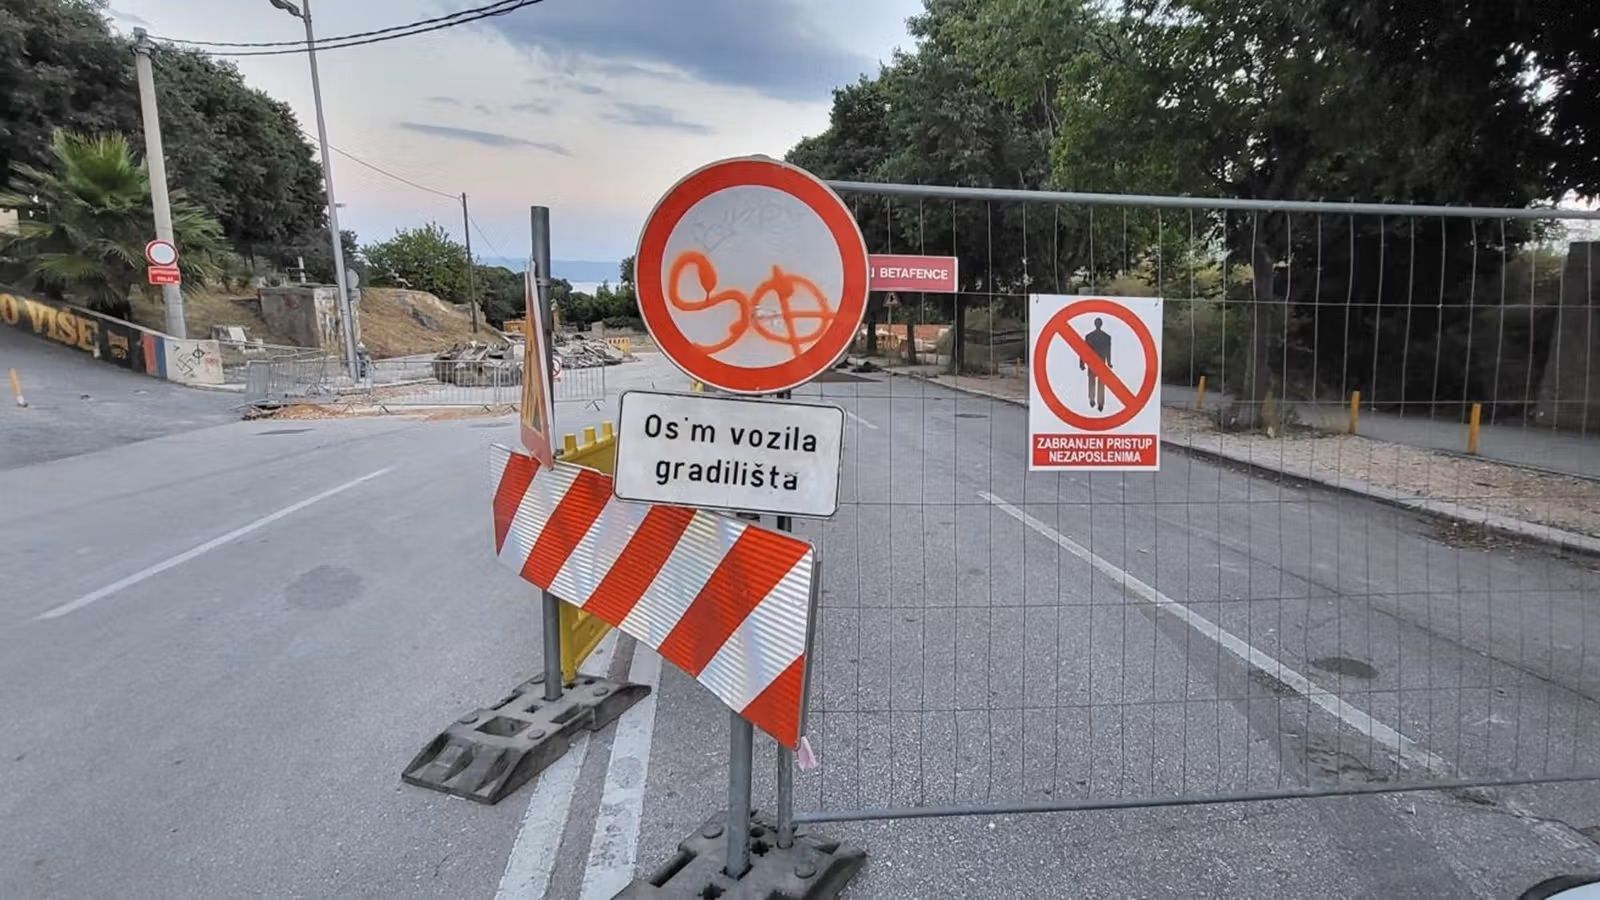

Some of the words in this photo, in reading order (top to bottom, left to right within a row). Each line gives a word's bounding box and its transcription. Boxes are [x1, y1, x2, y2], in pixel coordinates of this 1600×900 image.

[880, 267, 949, 280] BETAFENCE
[645, 413, 715, 443] Osm
[730, 426, 817, 452] vozila
[1037, 437, 1104, 449] ZABRANJEN
[1107, 438, 1153, 450] PRISTUP
[1049, 450, 1141, 463] NEZAPOSLENIMA
[656, 459, 798, 491] gradilišta
